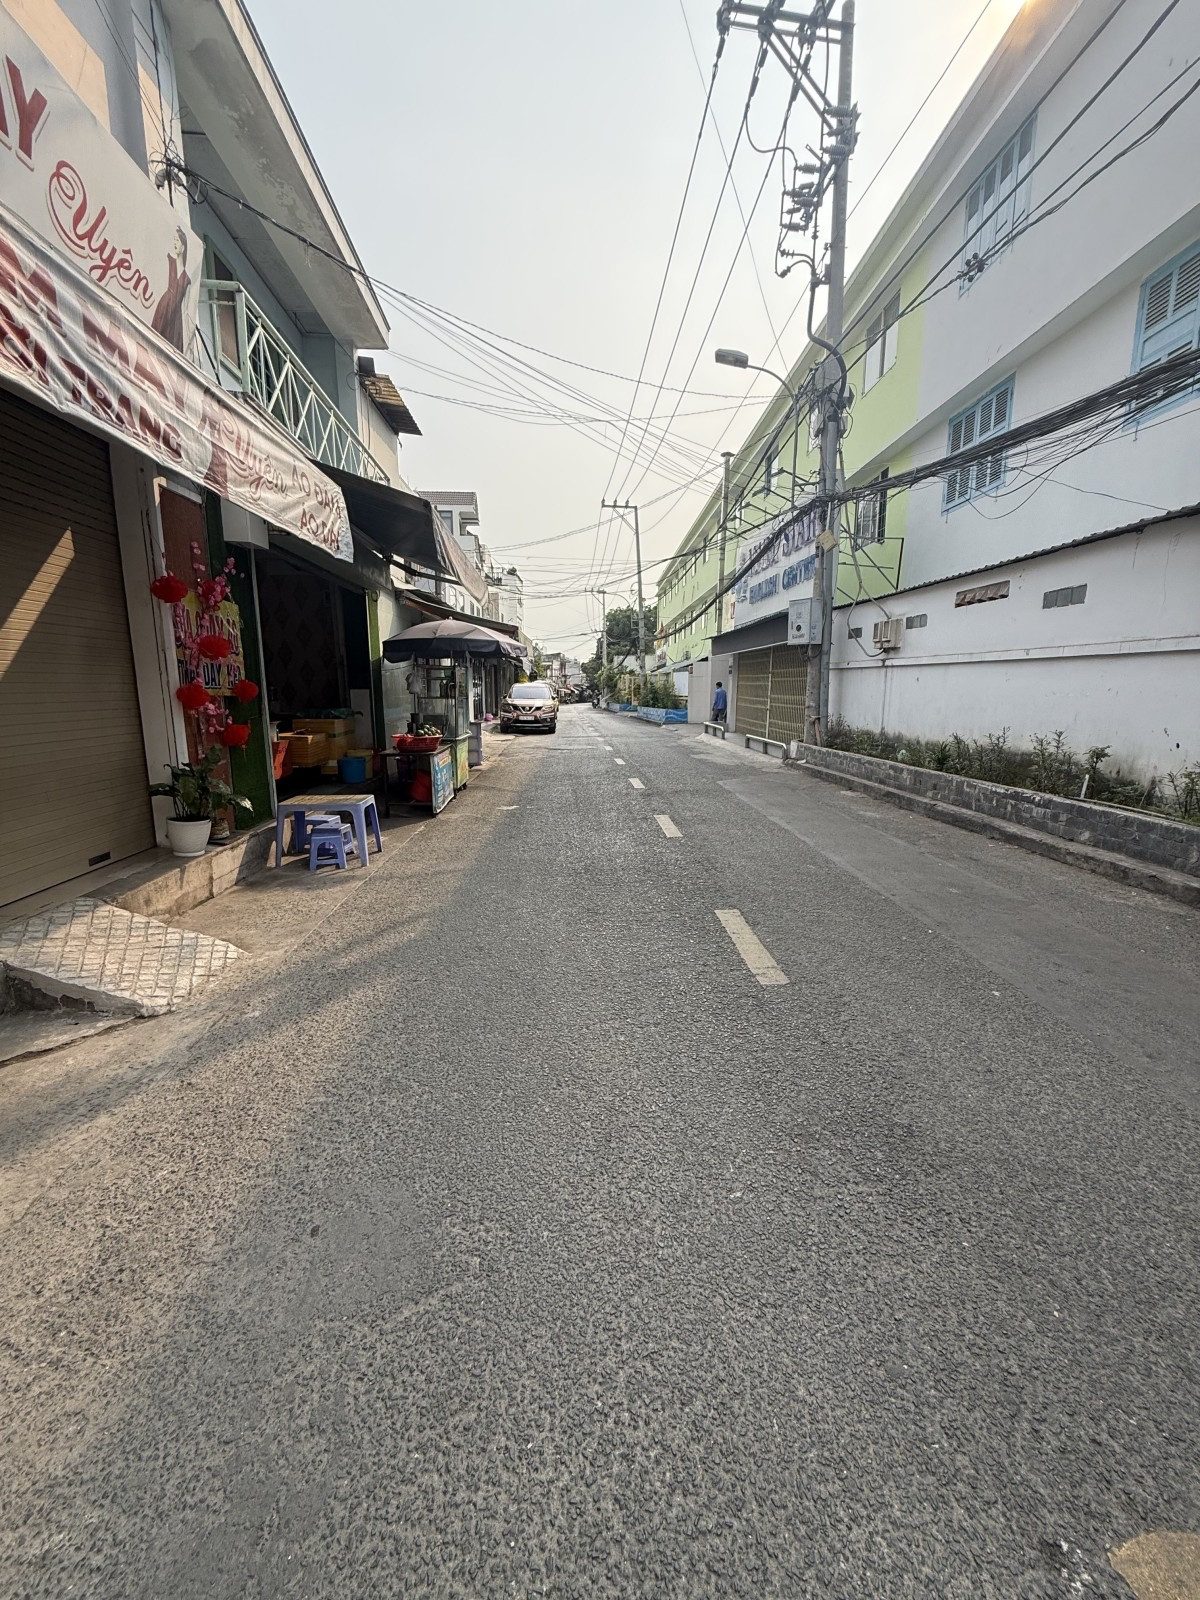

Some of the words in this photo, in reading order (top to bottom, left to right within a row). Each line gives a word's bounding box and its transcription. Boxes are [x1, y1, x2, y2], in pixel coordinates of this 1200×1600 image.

[0, 54, 48, 162] Y
[49, 160, 154, 301] Uyên
[59, 355, 184, 461] TRANG
